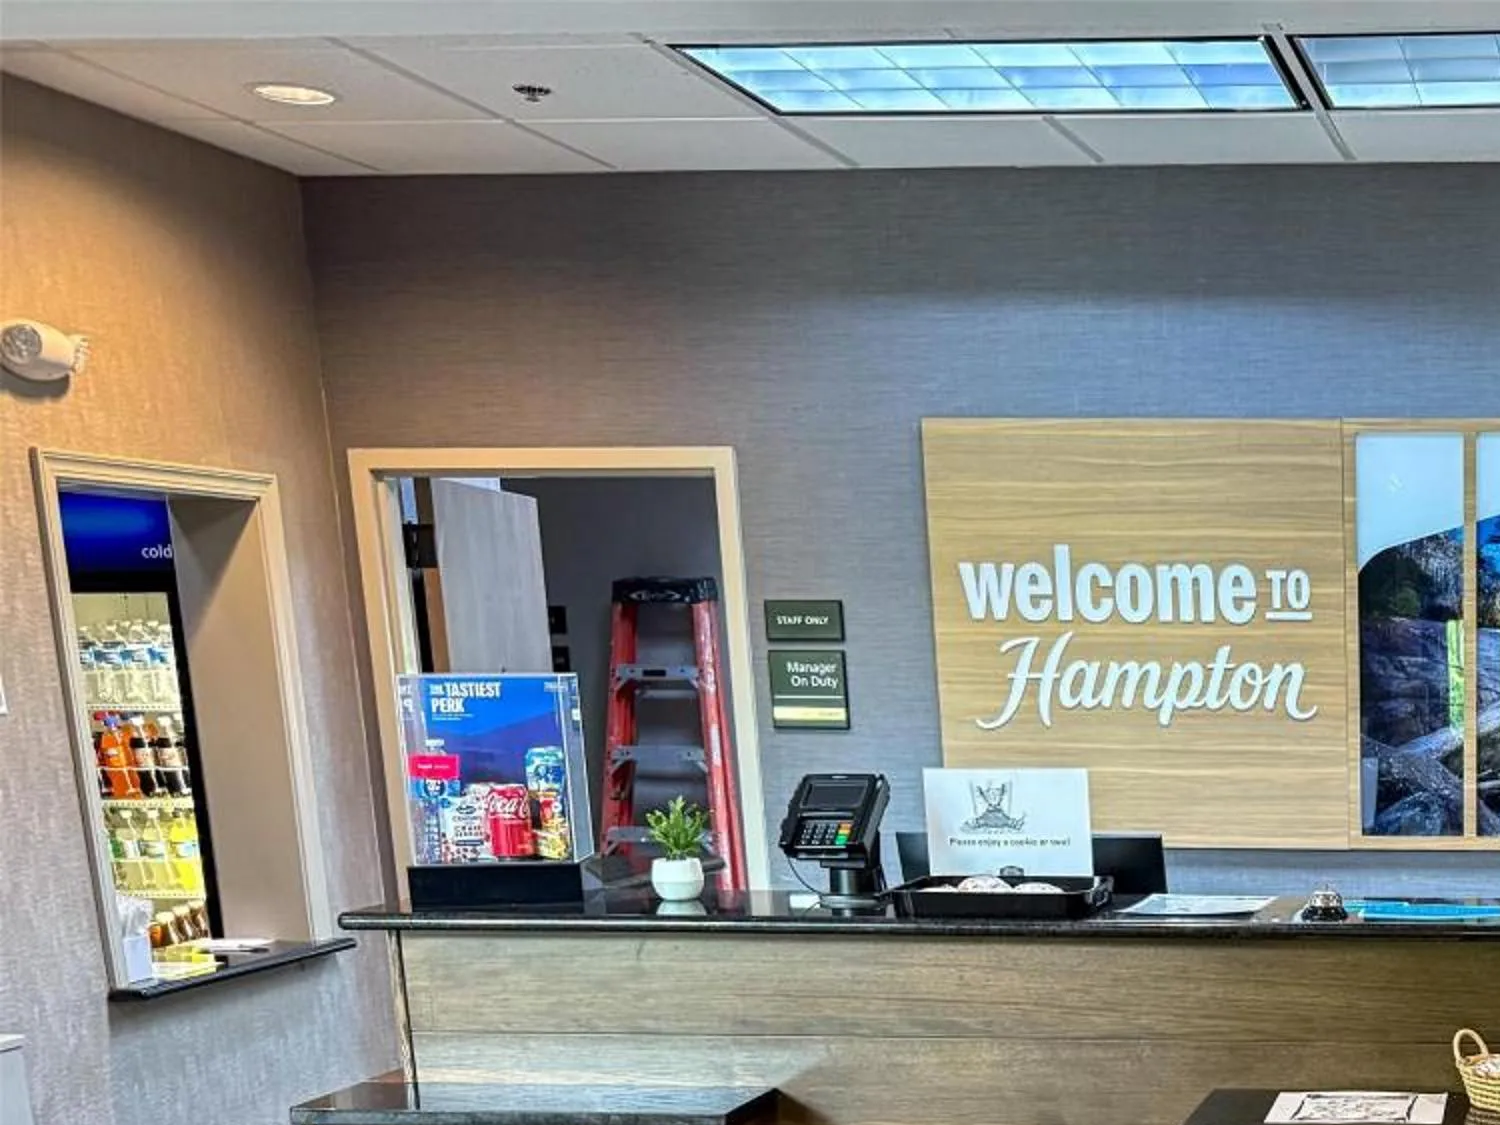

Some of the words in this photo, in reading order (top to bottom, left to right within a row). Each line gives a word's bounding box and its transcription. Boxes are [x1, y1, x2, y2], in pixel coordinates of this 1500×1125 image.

[141, 543, 172, 559] cold
[958, 543, 1257, 624] welcome
[1265, 568, 1312, 610] TO
[777, 615, 802, 625] STAFF
[804, 615, 829, 625] ONLY
[786, 661, 837, 675] Manager
[791, 675, 808, 687] On
[811, 675, 839, 689] Duty
[975, 631, 1318, 729] Hampton
[444, 681, 501, 698] TASTIEST
[431, 698, 465, 713] PERK
